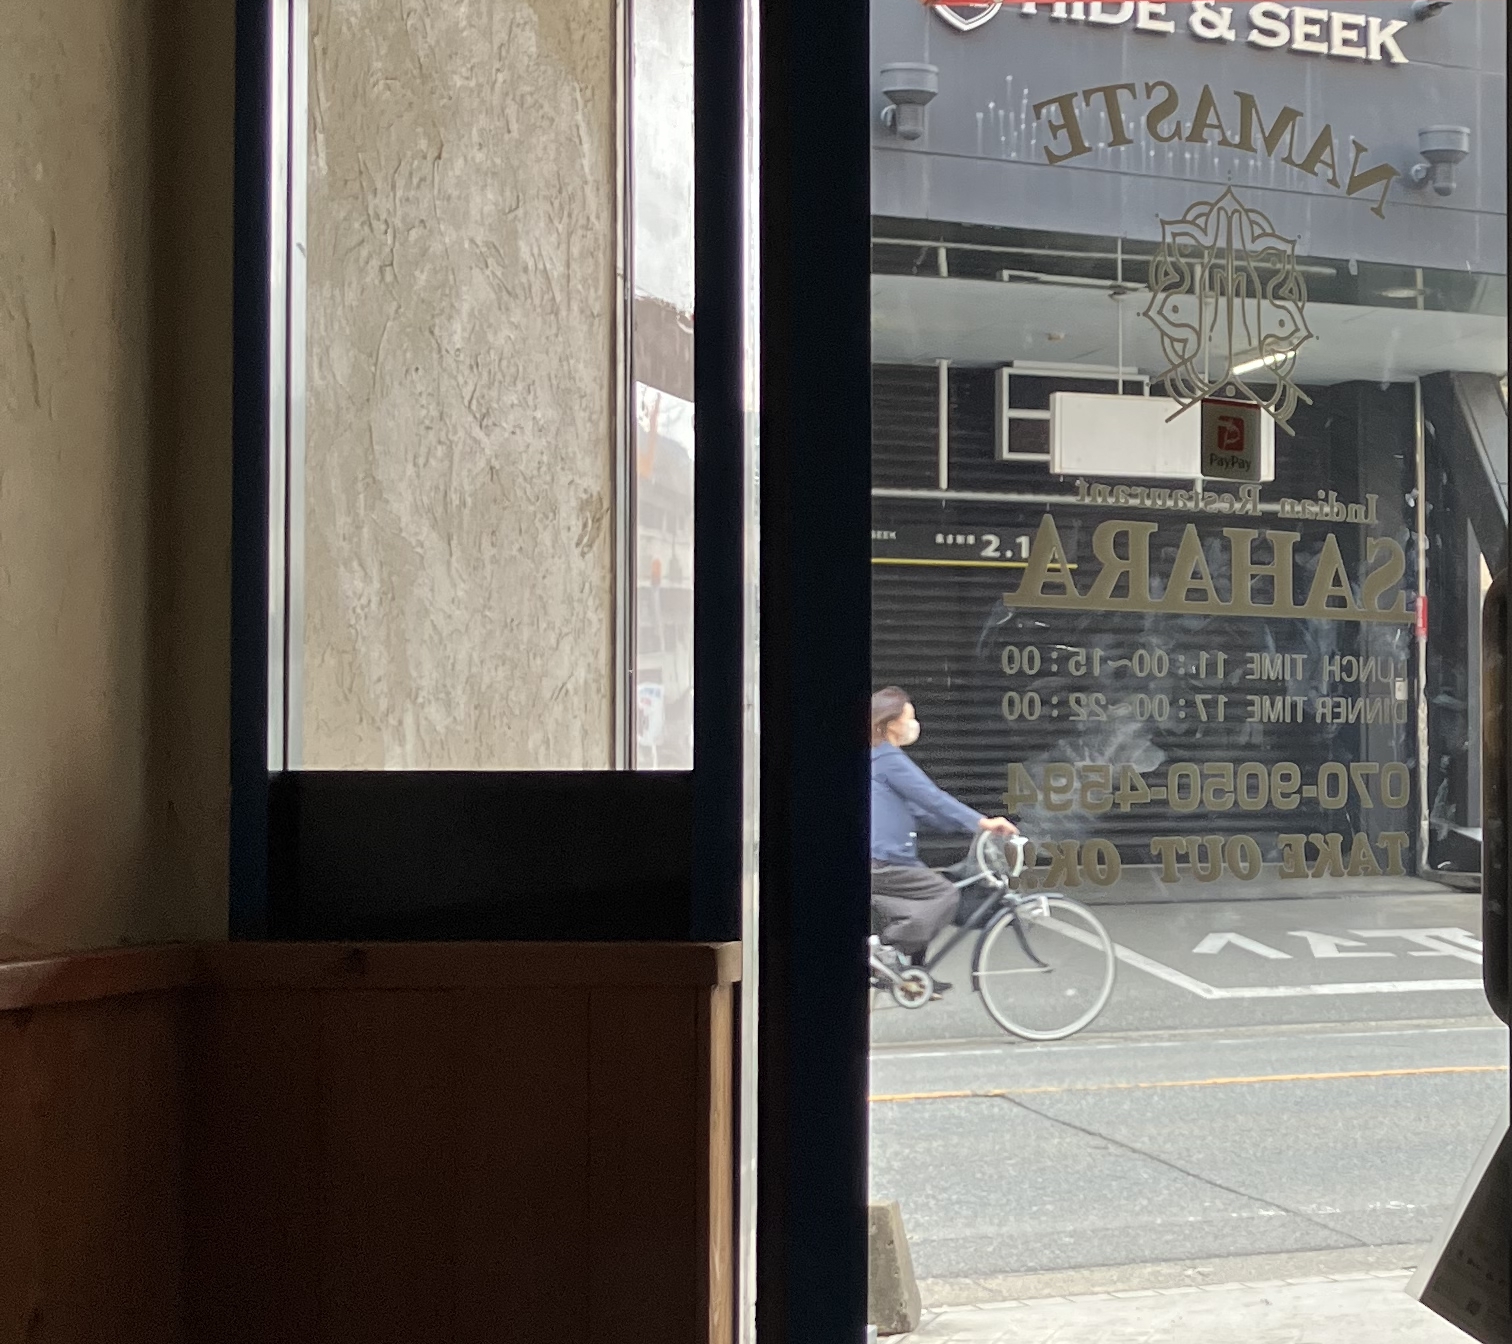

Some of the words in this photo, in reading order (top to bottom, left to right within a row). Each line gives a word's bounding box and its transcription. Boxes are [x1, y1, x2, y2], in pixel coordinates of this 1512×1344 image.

[1189, 0, 1236, 42] &
[1246, 2, 1409, 64] SEEK
[1208, 453, 1252, 472] PayPay
